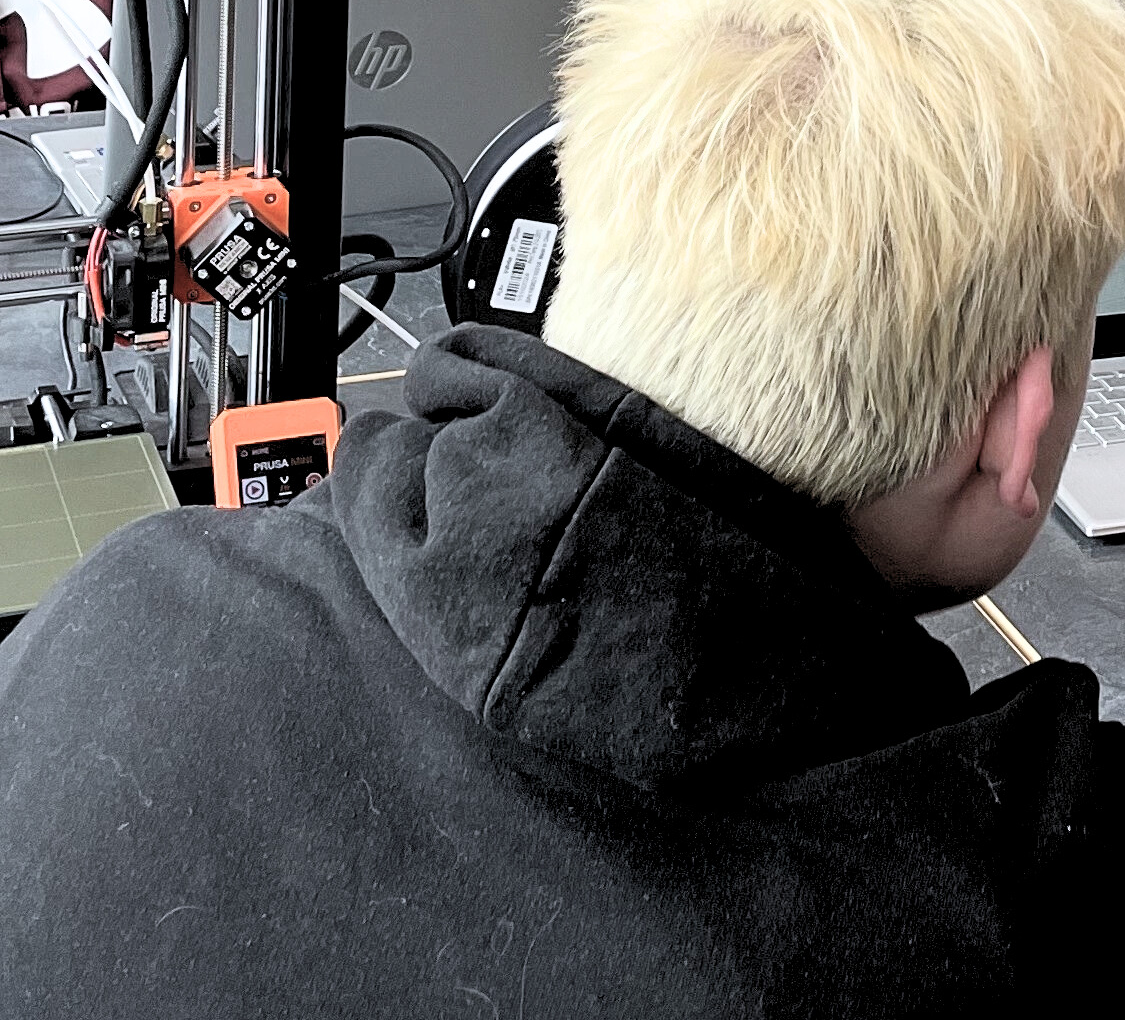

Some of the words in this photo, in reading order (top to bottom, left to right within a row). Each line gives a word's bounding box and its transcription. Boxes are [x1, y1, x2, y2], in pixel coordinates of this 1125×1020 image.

[354, 31, 408, 91] hp
[210, 235, 244, 266] PRUSA
[229, 282, 257, 310] ORIGINAL
[255, 261, 277, 283] PRUSA
[274, 247, 290, 262] MINI
[253, 458, 289, 472] PRUSA
